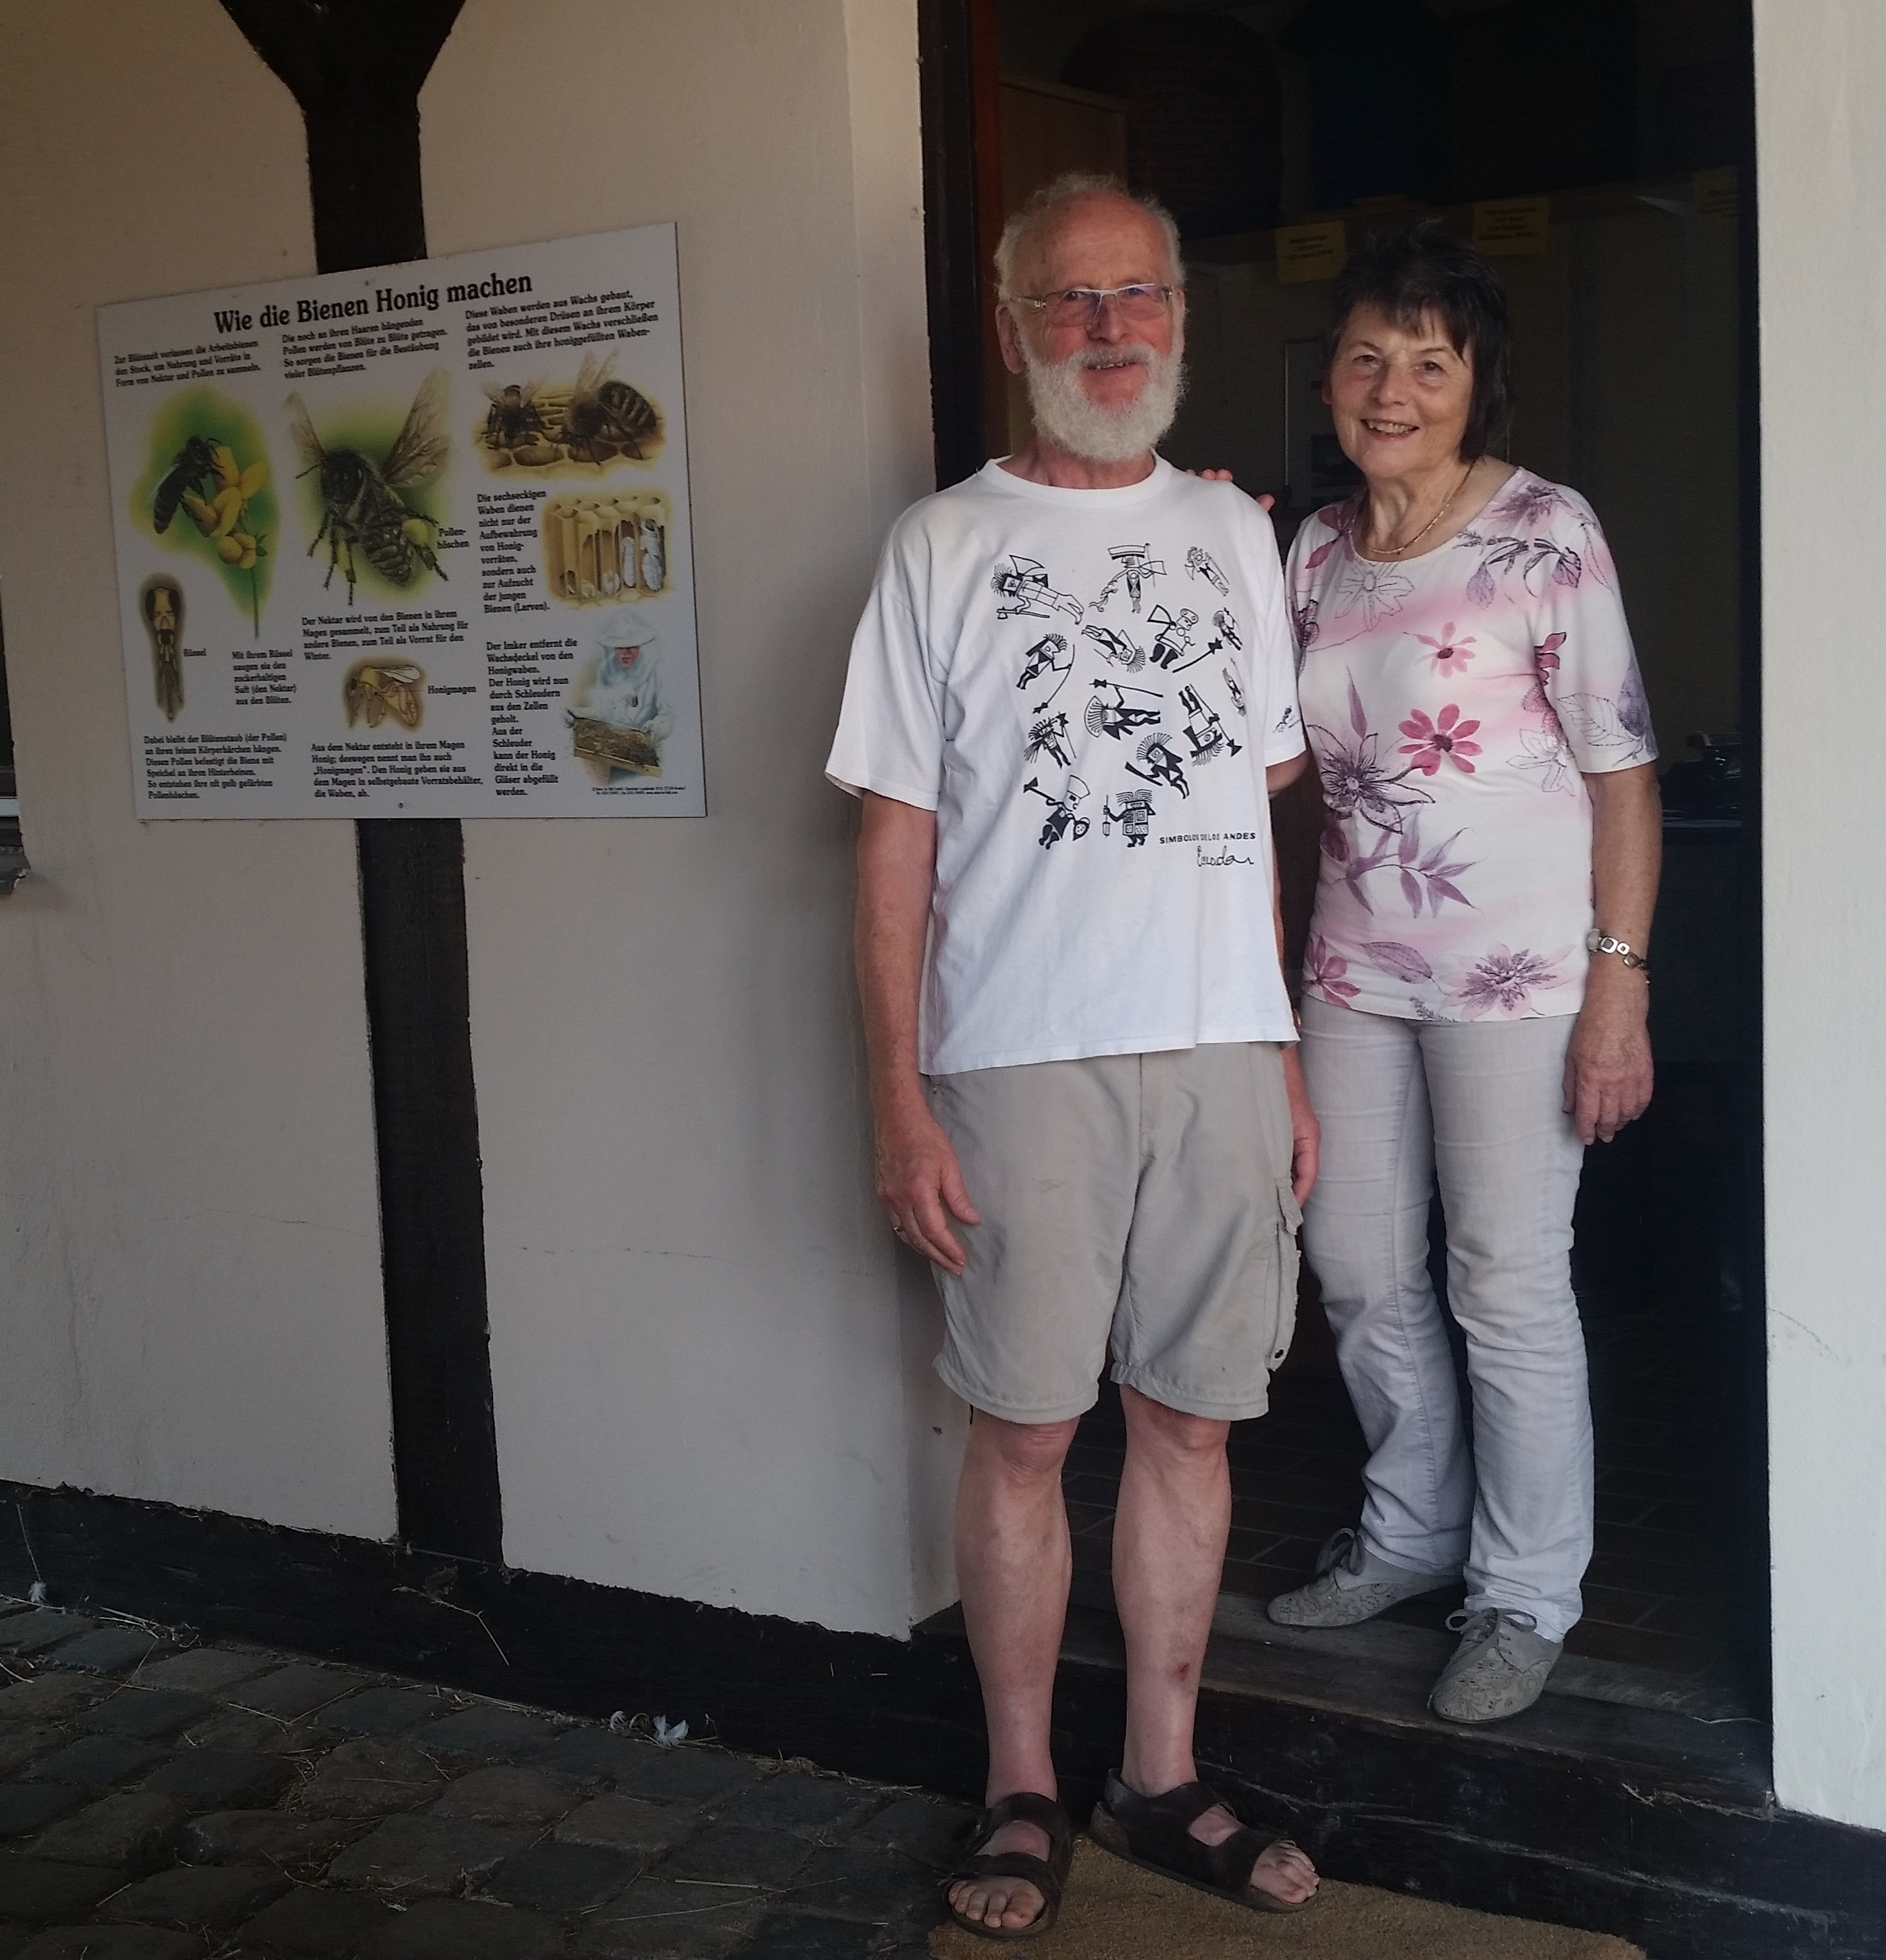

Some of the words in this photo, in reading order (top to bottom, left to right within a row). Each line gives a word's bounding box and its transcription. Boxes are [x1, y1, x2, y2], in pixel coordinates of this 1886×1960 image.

[213, 310, 253, 334] Wie
[259, 304, 290, 328] die
[296, 299, 369, 323] Bienen
[375, 284, 440, 313] Honig
[446, 272, 533, 303] machen
[436, 539, 470, 550] höschen
[486, 641, 502, 651] Der
[503, 640, 527, 650] Imker
[529, 639, 563, 649] entfernt
[565, 637, 578, 647] die
[558, 651, 574, 660] den
[488, 678, 504, 687] Der
[505, 677, 531, 688] Honig
[532, 676, 551, 685] wird
[489, 689, 513, 699] durch
[506, 701, 522, 711] den
[523, 701, 548, 710] Zellen
[492, 727, 507, 736] Aus
[509, 726, 523, 735] der
[492, 738, 533, 747] Schleuder
[493, 751, 513, 760] kann
[515, 750, 529, 760] der
[531, 750, 556, 761] Honig
[494, 762, 519, 772] direkt
[520, 763, 529, 771] in
[530, 762, 543, 771] die
[494, 775, 521, 784] Gläser
[523, 774, 559, 785] abgefüllt
[1223, 832, 1256, 841] ANDES
